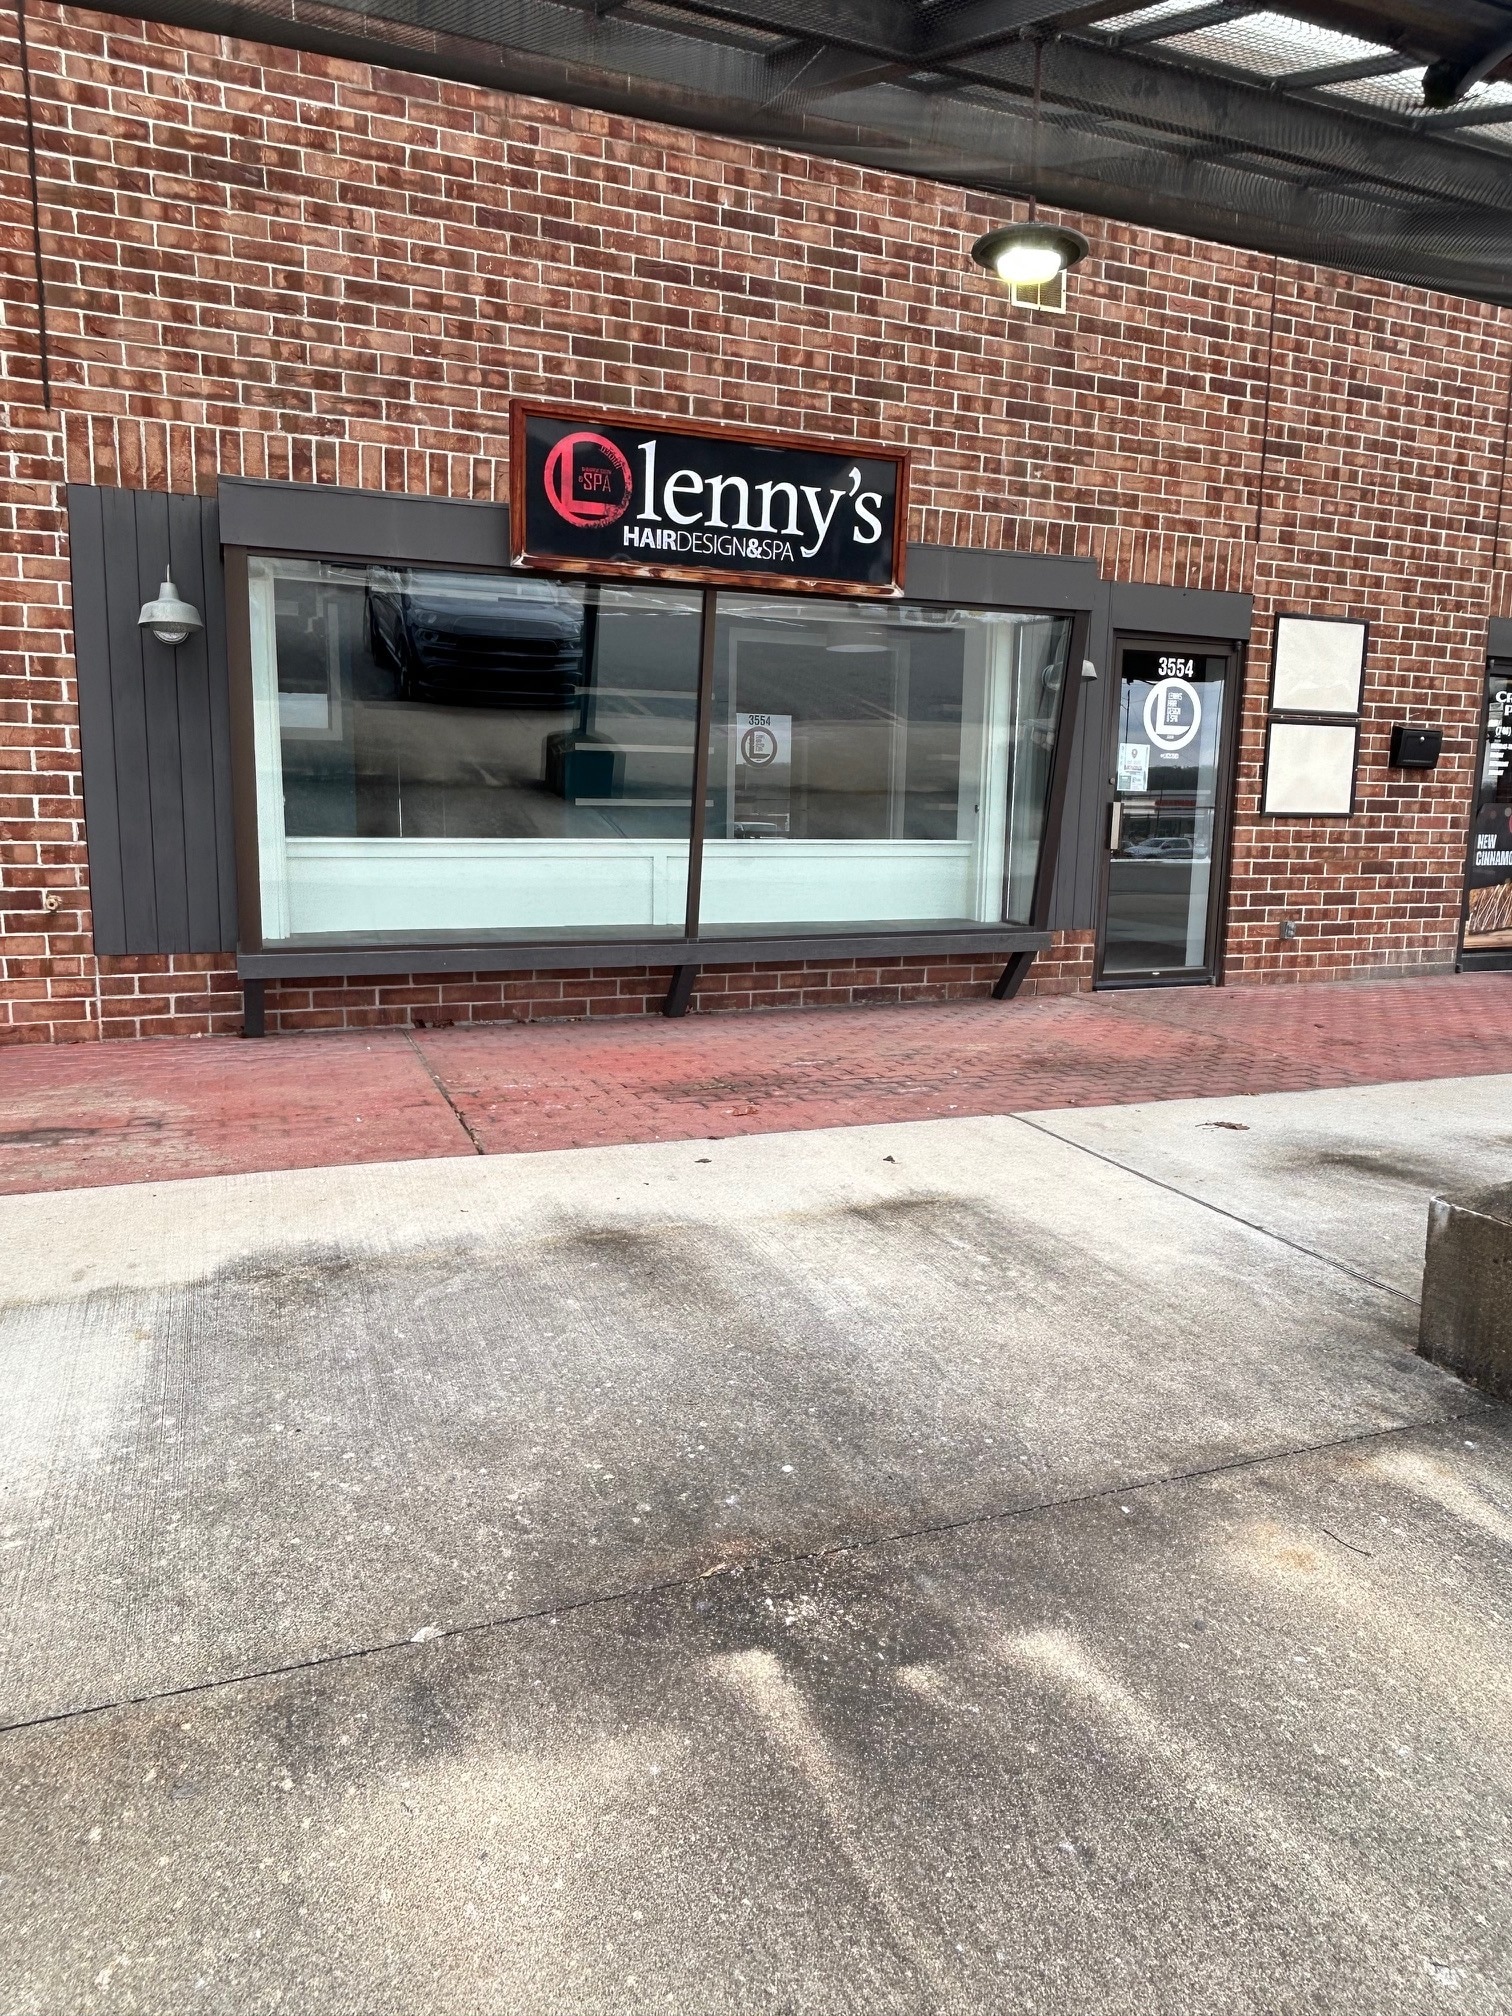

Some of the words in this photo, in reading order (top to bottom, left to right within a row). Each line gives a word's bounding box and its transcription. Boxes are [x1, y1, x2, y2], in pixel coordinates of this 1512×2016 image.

[637, 440, 883, 557] lenny's
[1158, 657, 1194, 678] 3554
[748, 715, 771, 726] 3554
[1477, 834, 1497, 849] NEW
